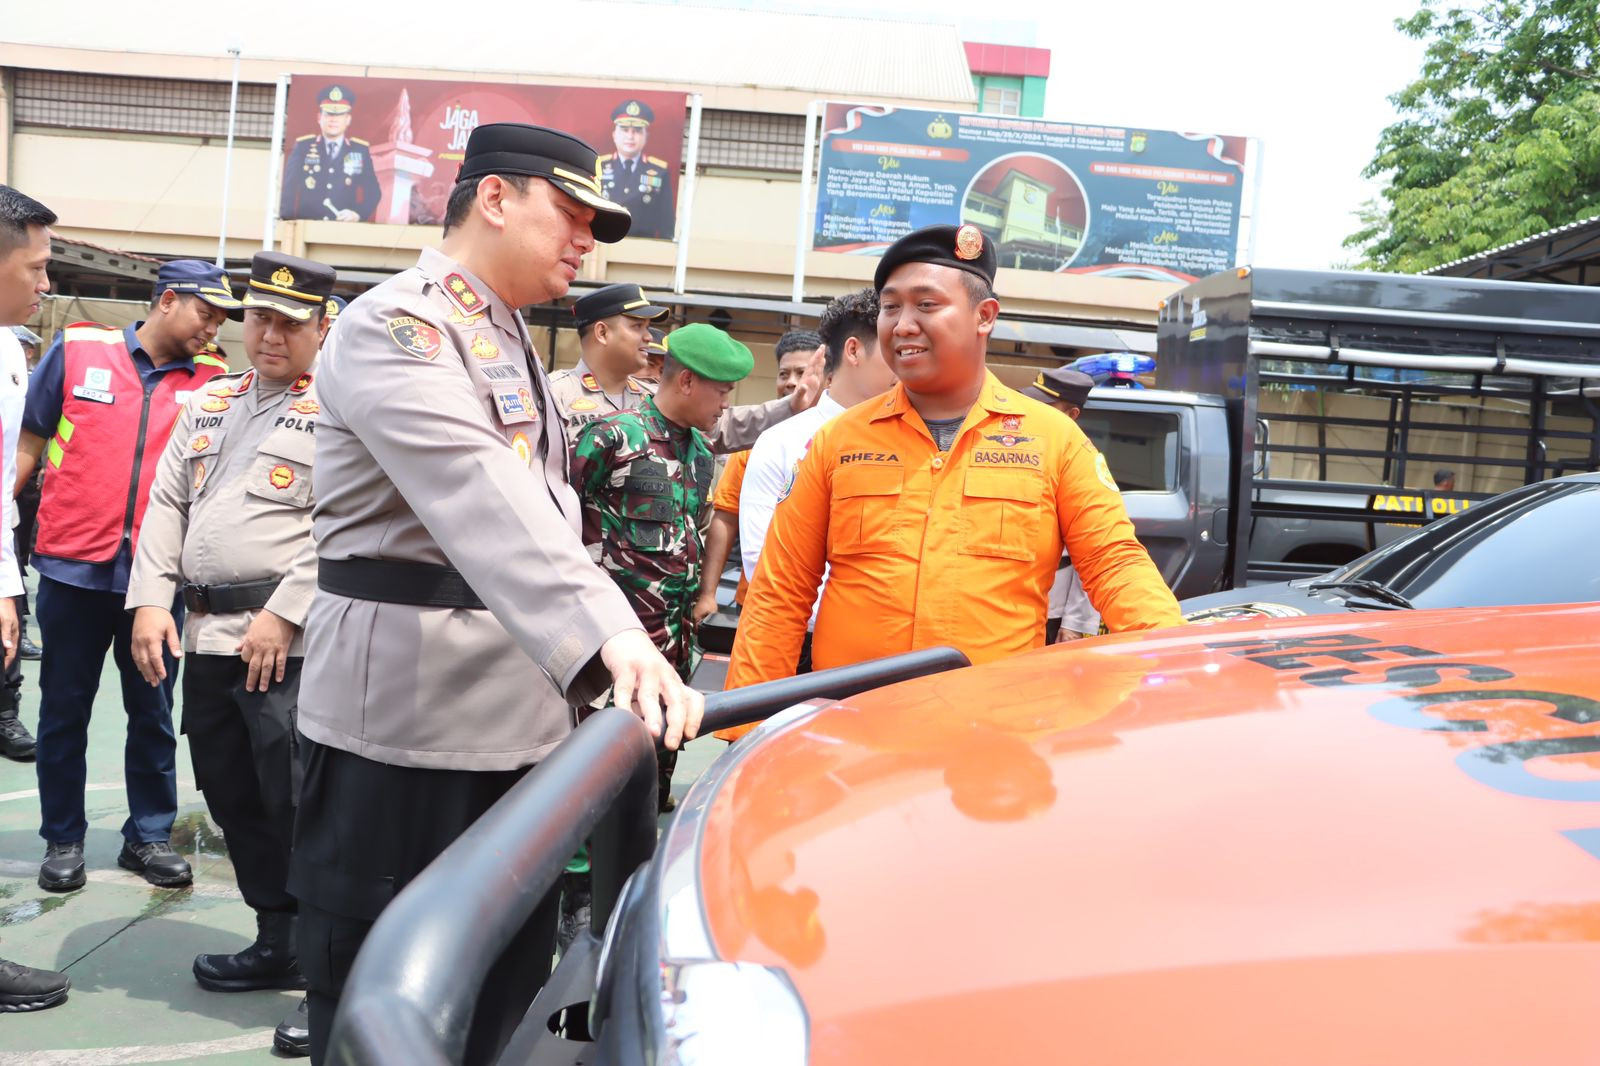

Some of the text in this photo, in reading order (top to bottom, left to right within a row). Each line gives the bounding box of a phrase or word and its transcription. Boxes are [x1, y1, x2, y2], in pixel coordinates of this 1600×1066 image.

[440, 106, 478, 130] JAGA
[448, 127, 472, 150] JA
[850, 176, 868, 187] Jaya
[889, 179, 907, 189] Yang
[876, 171, 902, 180] Daerah
[904, 173, 929, 182] Hukum
[827, 188, 844, 198] Yang
[892, 193, 910, 202] Pada
[195, 416, 224, 429] YUDI
[275, 417, 315, 433] POLR
[840, 452, 899, 465] RHEZA
[974, 450, 1040, 466] BASARNAS
